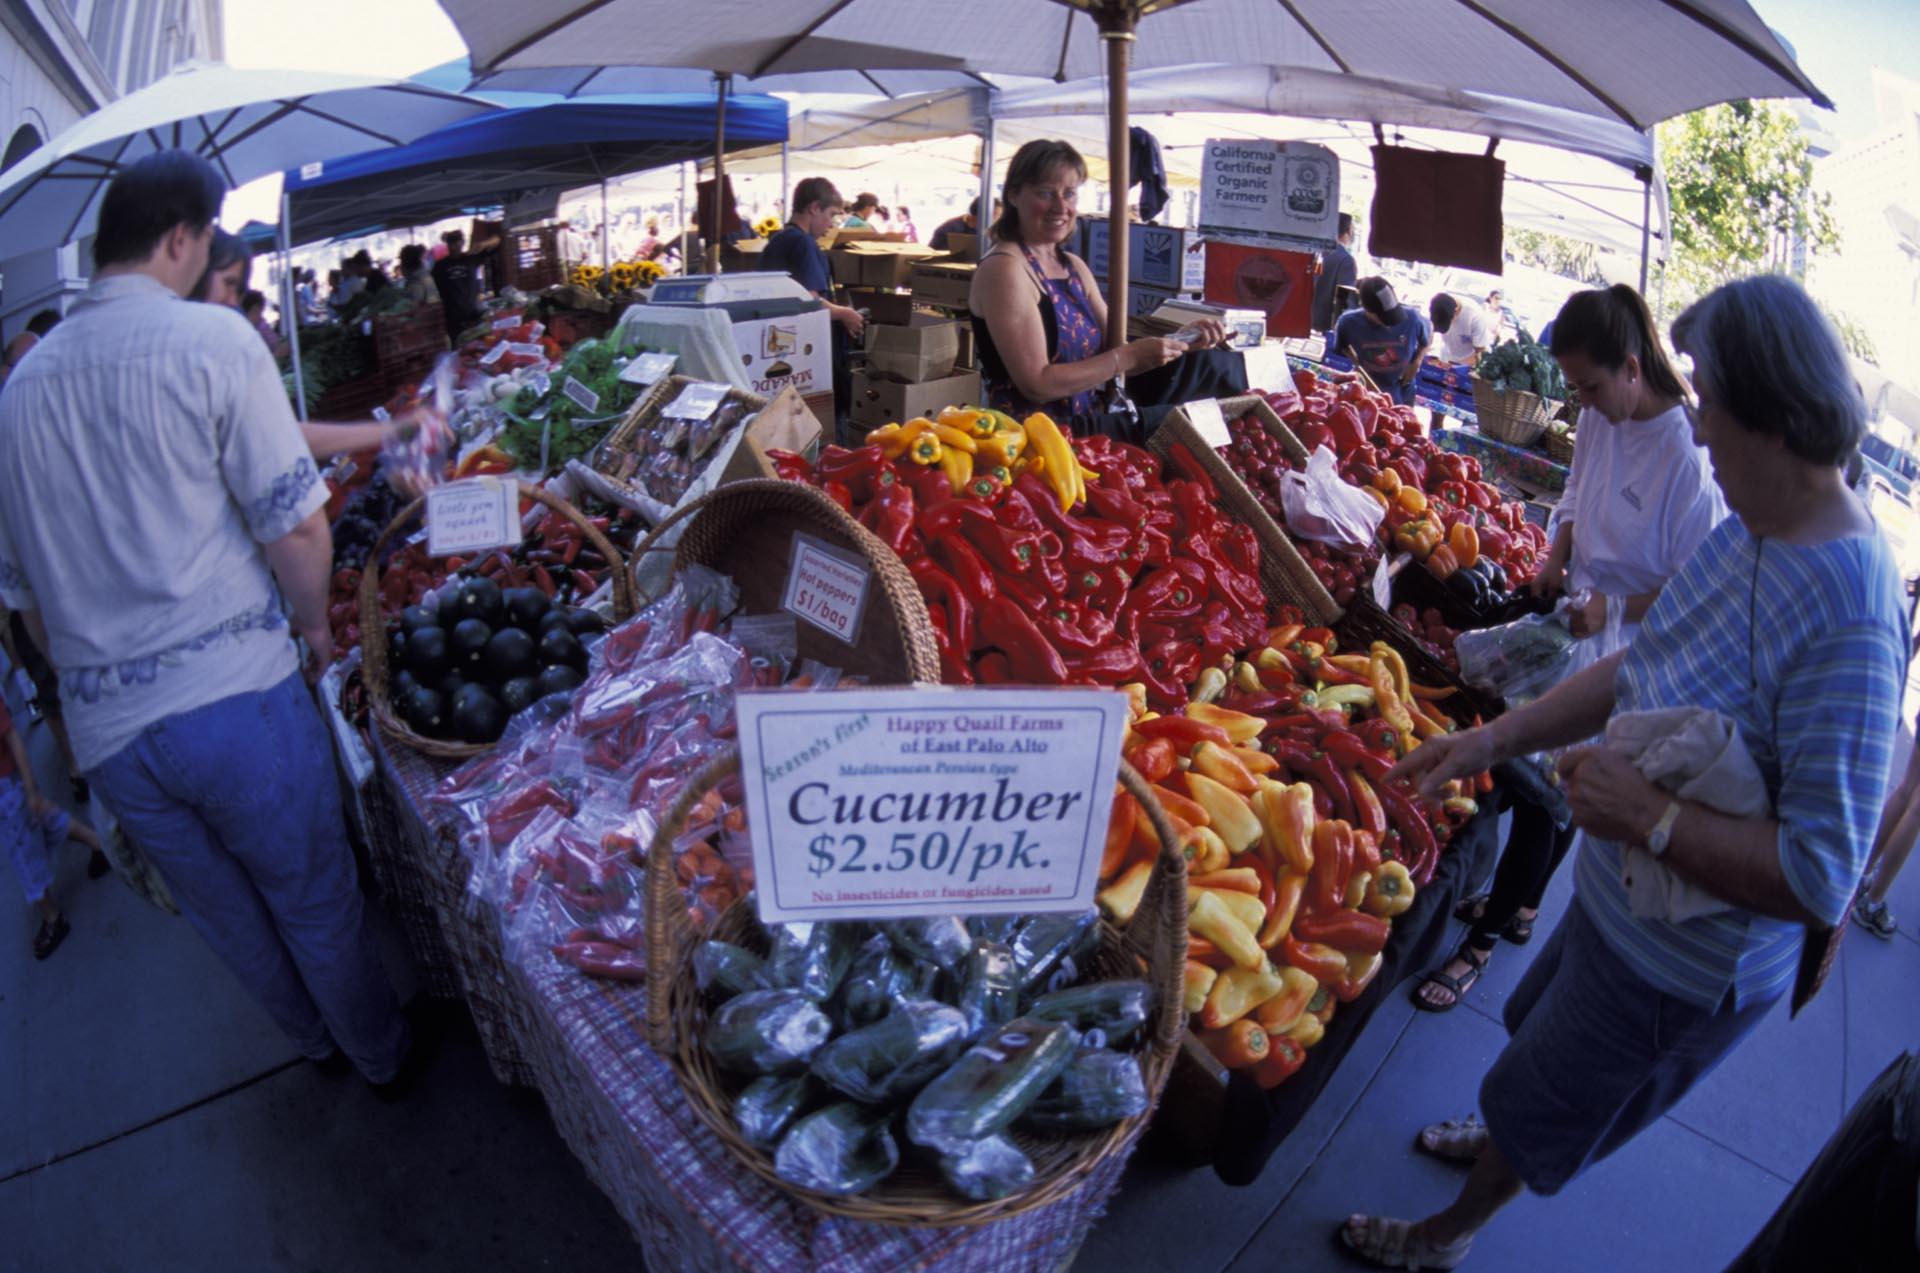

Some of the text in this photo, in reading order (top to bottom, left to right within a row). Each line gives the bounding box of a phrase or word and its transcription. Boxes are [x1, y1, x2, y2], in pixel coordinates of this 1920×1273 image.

[1211, 146, 1276, 162] California
[1214, 160, 1273, 175] Certified
[1217, 174, 1269, 191] Organic
[1216, 189, 1268, 204] Farmers
[800, 568, 858, 607] Hot peppers
[797, 589, 848, 630] $1/bag
[887, 715, 1063, 734] Happy Quail Farms
[900, 738, 1048, 753] of East Palo Alto
[764, 738, 831, 782] Season's
[788, 778, 1082, 826] Cucumber
[808, 827, 1052, 883] $2.50/pk.
[812, 884, 1053, 903] No insecticides or fungicides used
